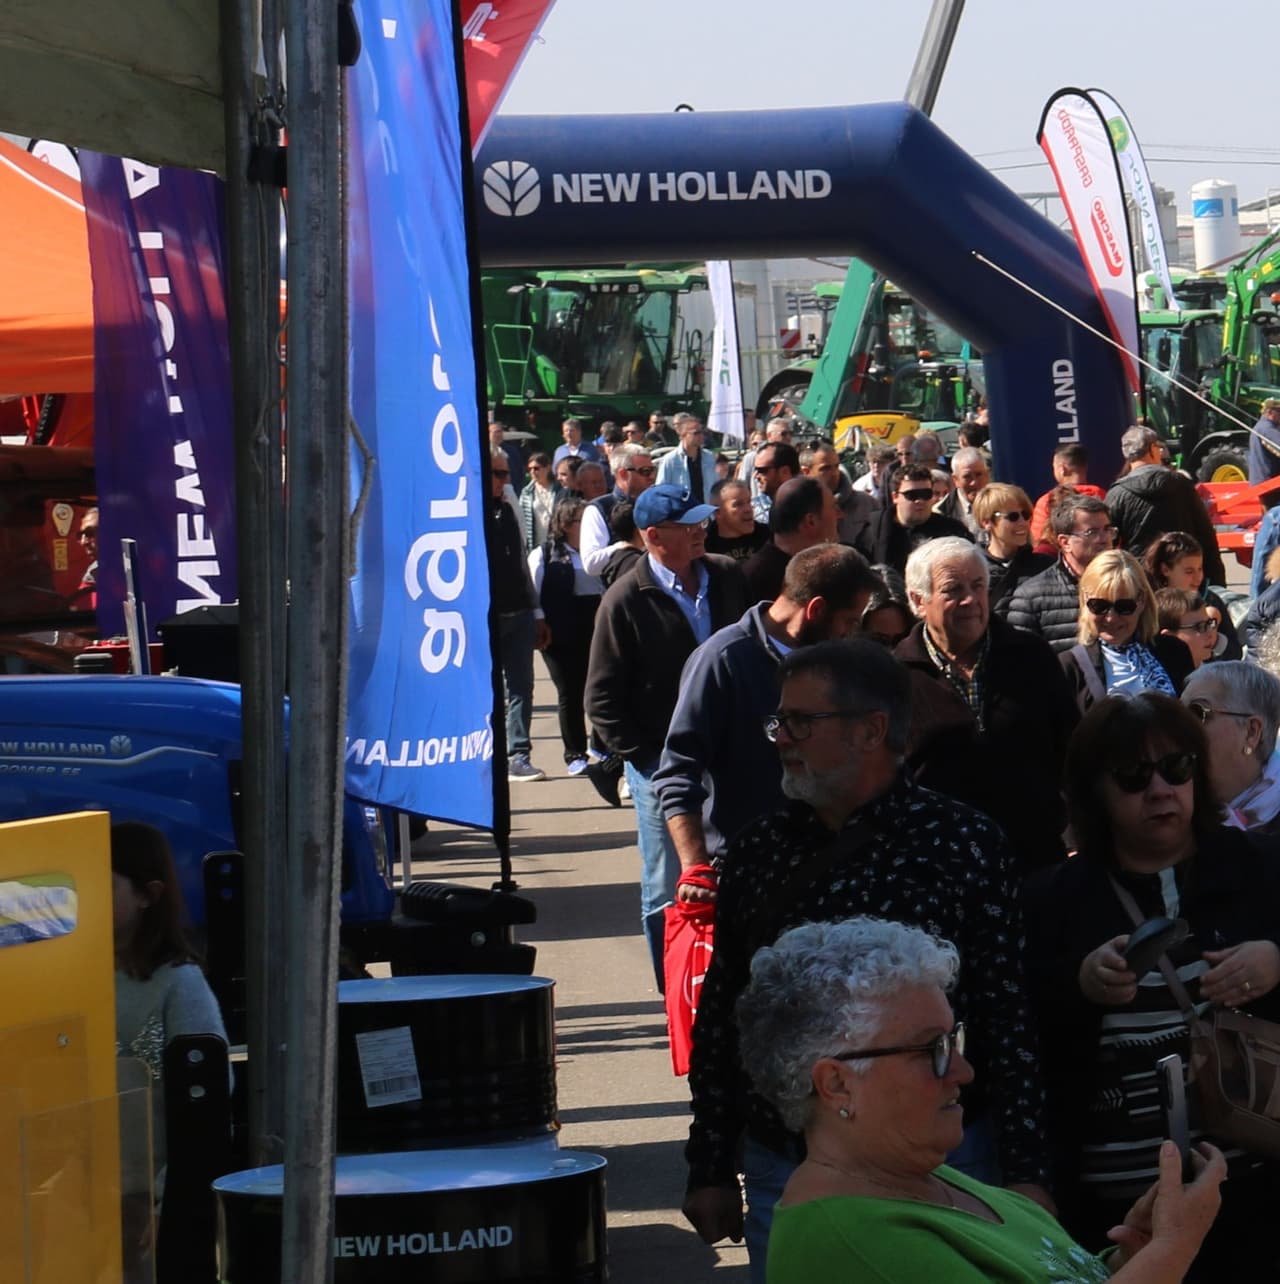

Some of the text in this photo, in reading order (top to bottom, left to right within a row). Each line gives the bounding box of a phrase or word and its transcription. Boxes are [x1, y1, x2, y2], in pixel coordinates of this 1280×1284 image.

[552, 169, 832, 203] NEW HOLLAND
[1052, 359, 1080, 443] LLAND
[24, 741, 106, 754] HOLLAND
[387, 1225, 513, 1255] HOLLAND
